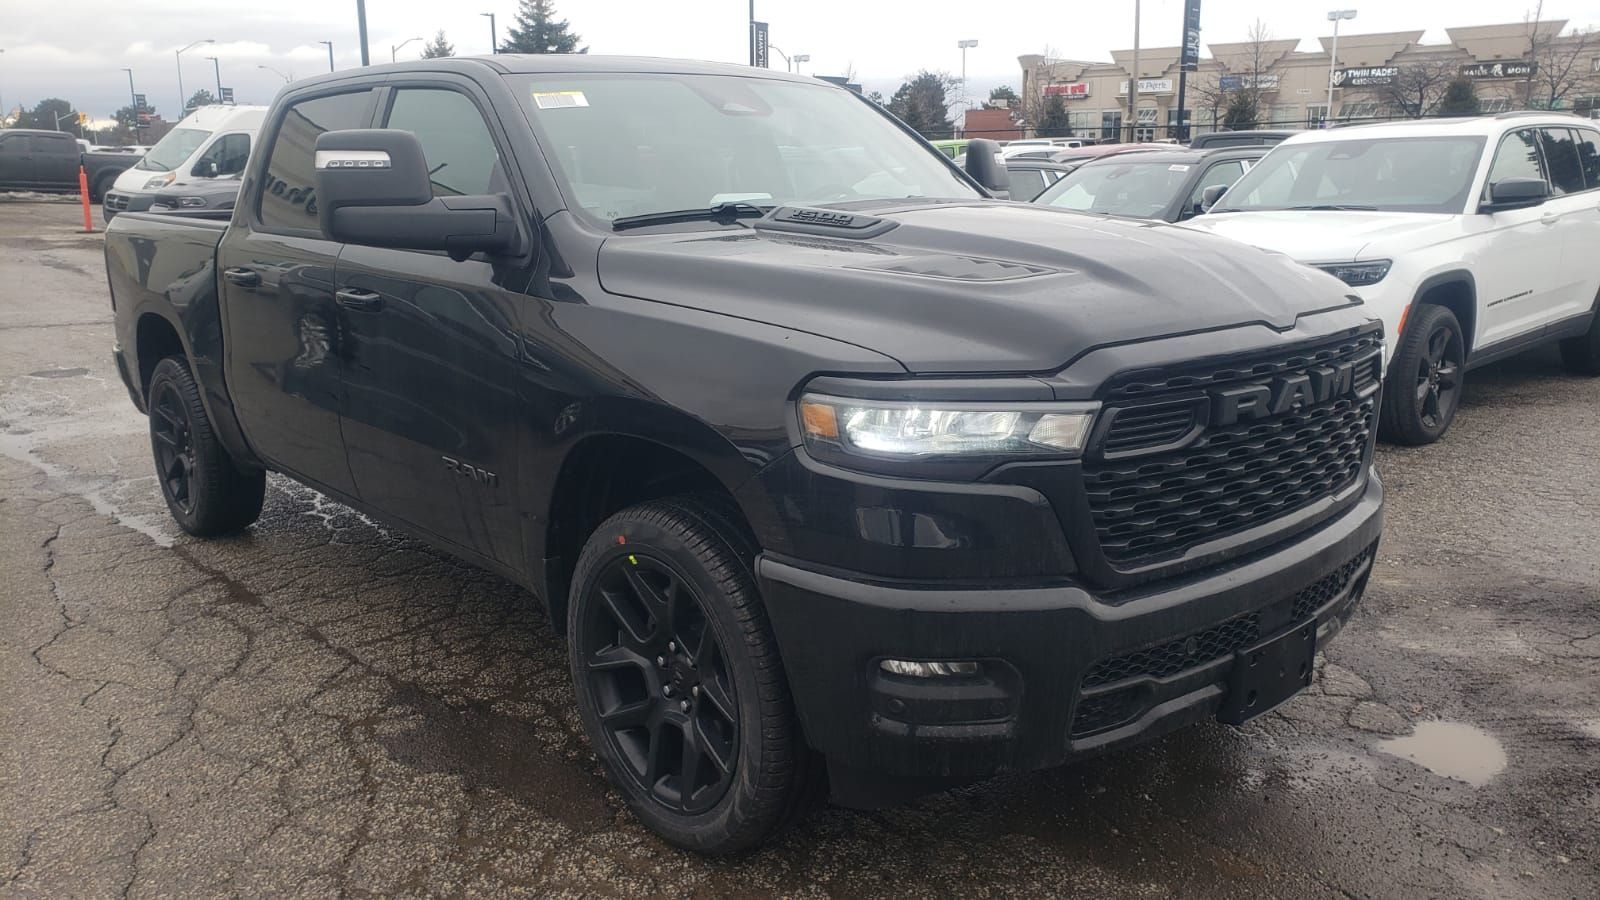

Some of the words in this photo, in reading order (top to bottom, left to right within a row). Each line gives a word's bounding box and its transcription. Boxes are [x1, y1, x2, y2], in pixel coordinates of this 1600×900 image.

[1347, 69, 1370, 78] TWIN
[1371, 67, 1398, 77] FADES
[1207, 361, 1352, 425] RAM
[441, 455, 498, 488] RAM
